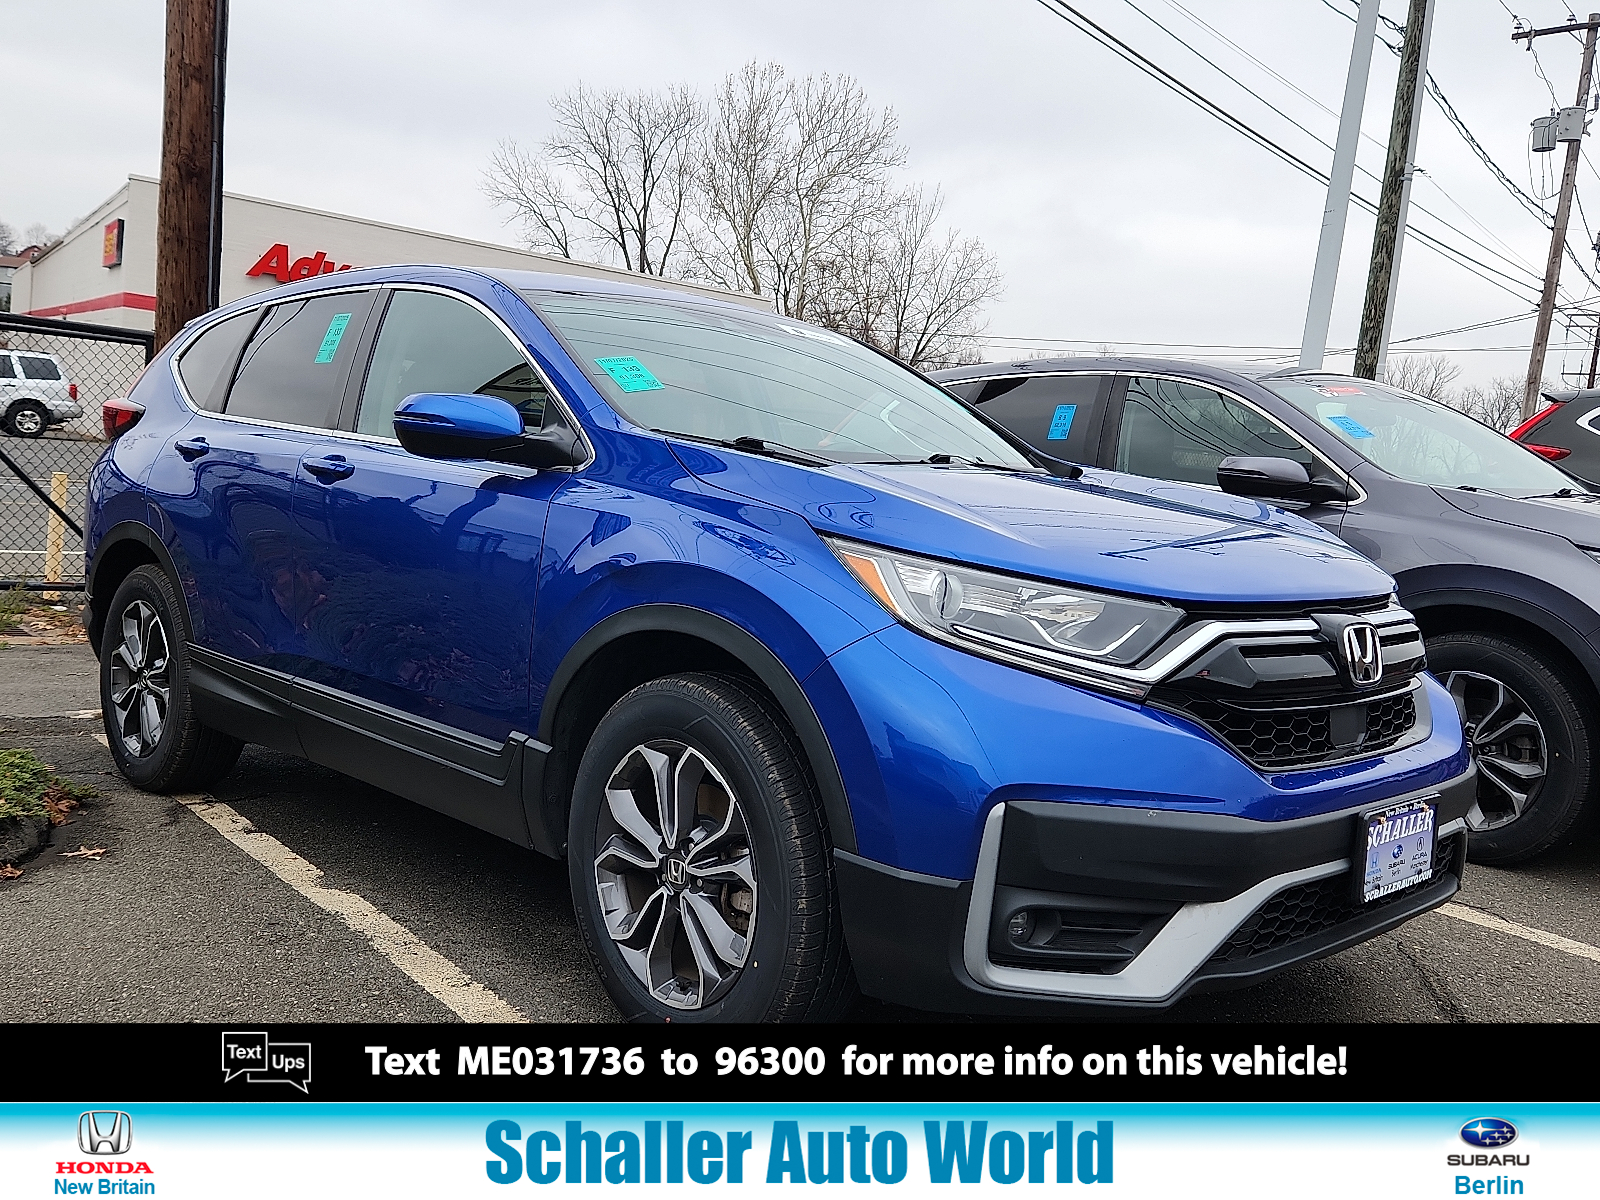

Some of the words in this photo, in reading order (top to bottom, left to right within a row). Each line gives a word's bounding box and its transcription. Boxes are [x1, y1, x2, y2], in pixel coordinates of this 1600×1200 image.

[1366, 809, 1434, 851] SCHALLER
[1411, 851, 1428, 861] ACURA
[1387, 859, 1406, 870] SUBARU
